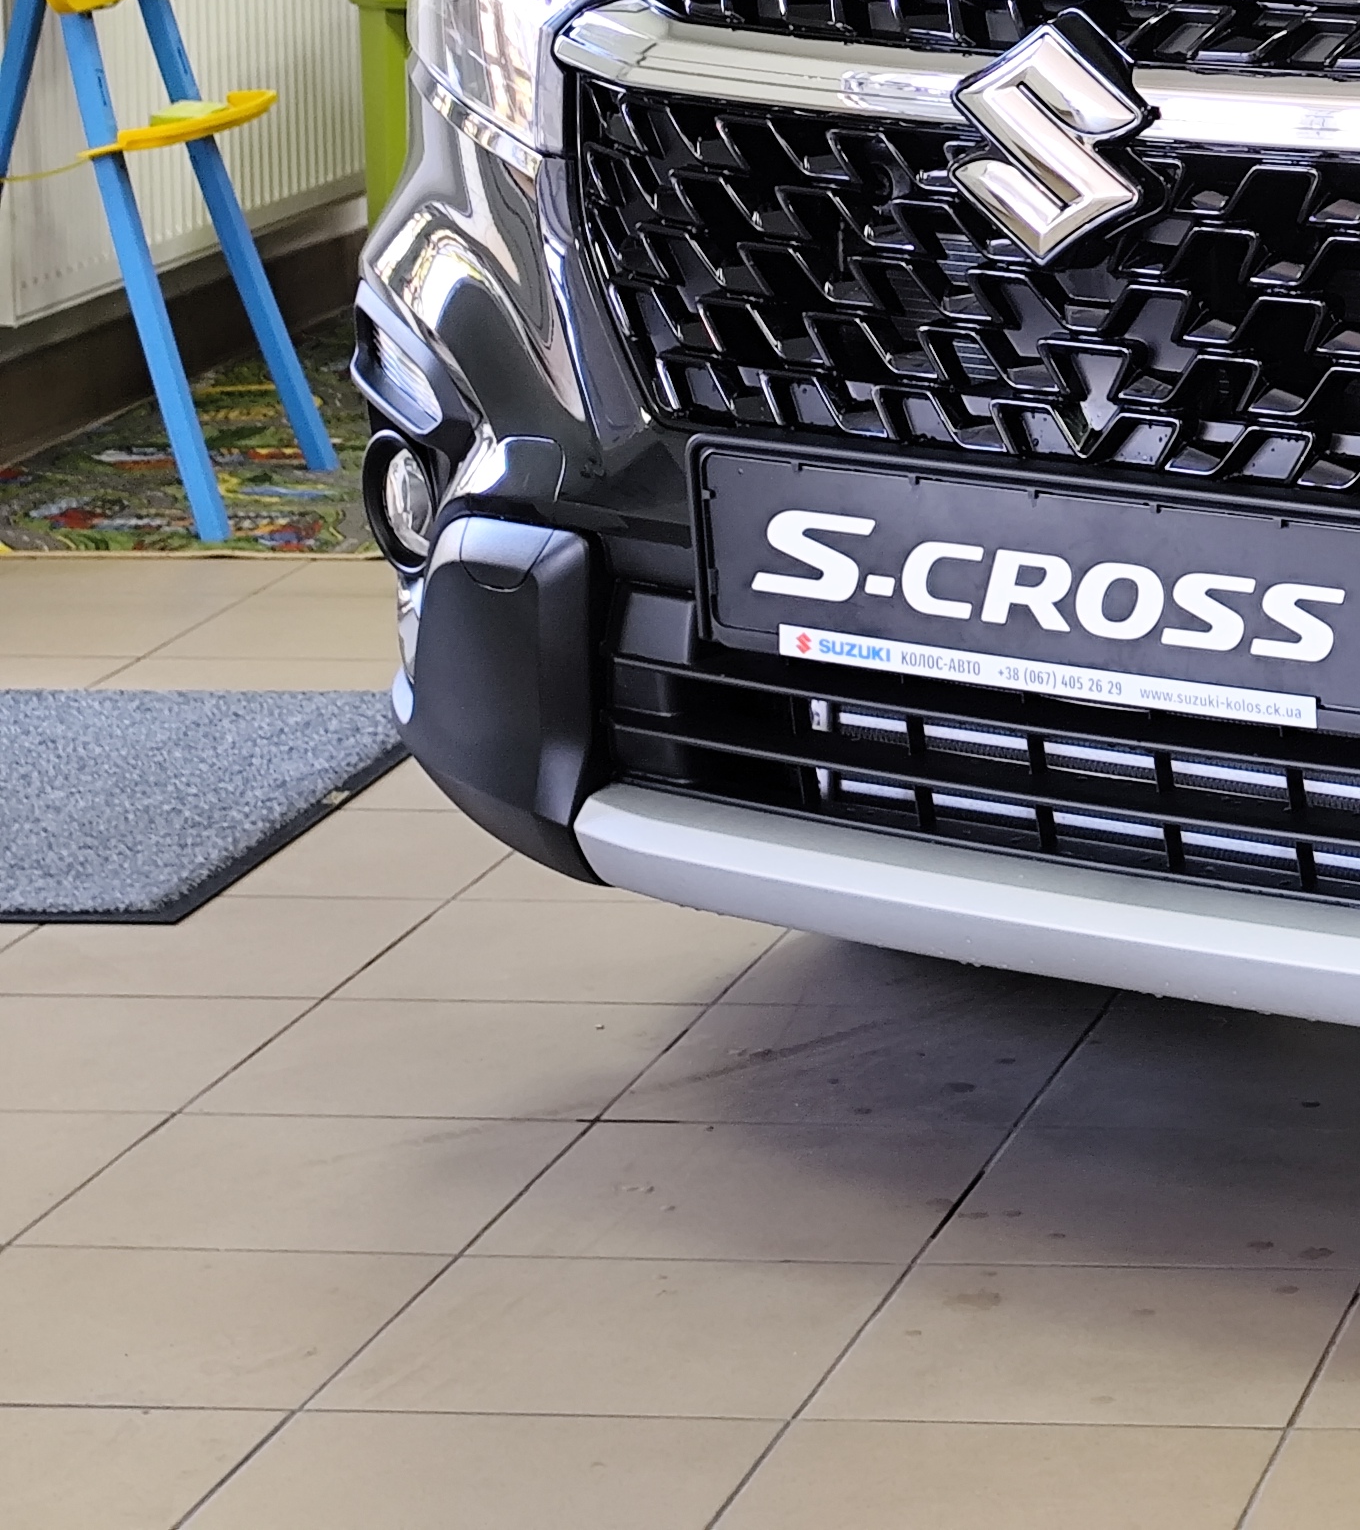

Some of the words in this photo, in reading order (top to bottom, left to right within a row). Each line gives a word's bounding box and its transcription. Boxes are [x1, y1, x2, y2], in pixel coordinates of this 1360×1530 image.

[818, 637, 892, 663] SUZUKI
[900, 650, 982, 677] КОЛОС-АВТО
[997, 665, 1020, 682] +38
[1023, 666, 1058, 690] (067)
[1061, 673, 1084, 691] 405
[1088, 677, 1104, 694] 26
[1107, 680, 1123, 697] 29
[1139, 687, 1303, 720] www.suzuki-kolos.ck.ua
